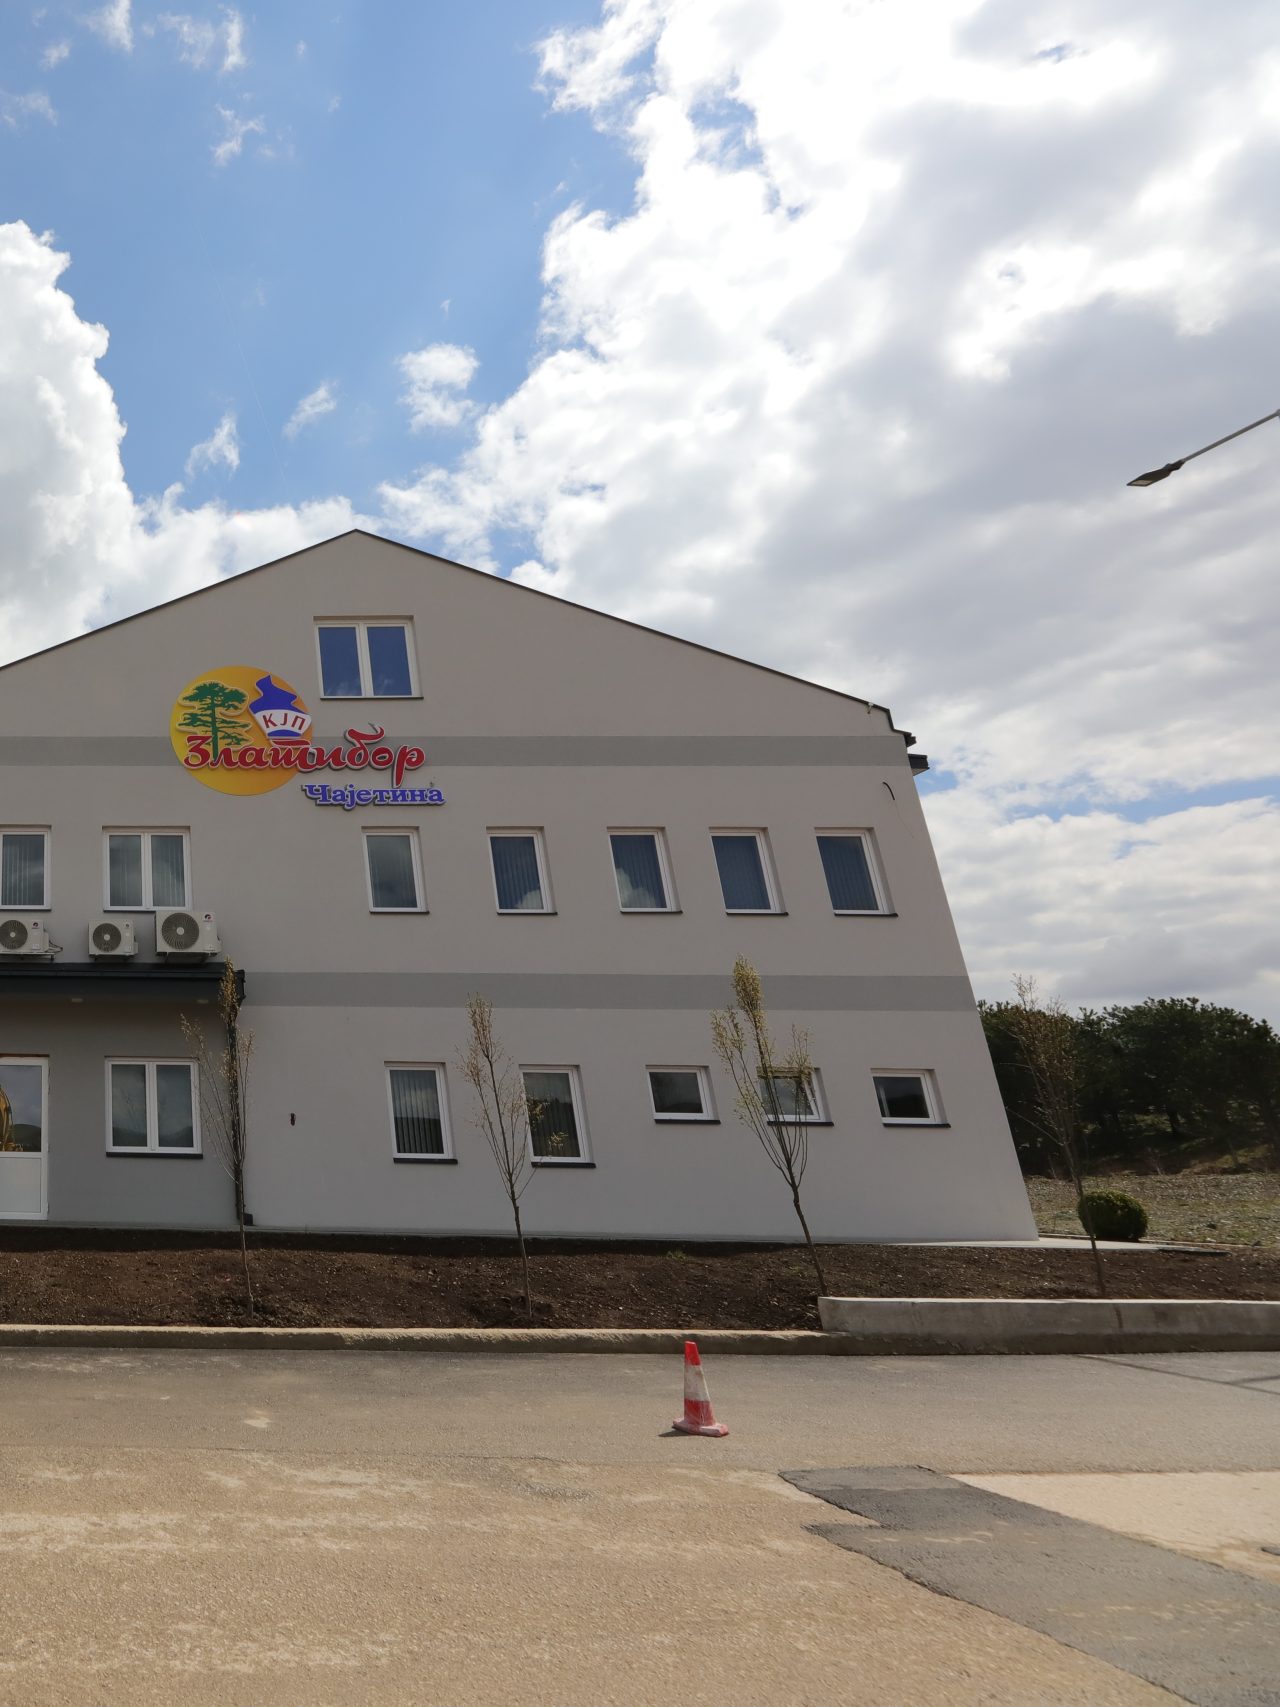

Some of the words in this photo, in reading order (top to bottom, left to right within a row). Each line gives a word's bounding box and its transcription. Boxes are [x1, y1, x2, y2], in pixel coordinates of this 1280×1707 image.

[262, 712, 306, 731] КЈП
[182, 725, 426, 788] Златибор
[302, 783, 445, 809] Чајетина
